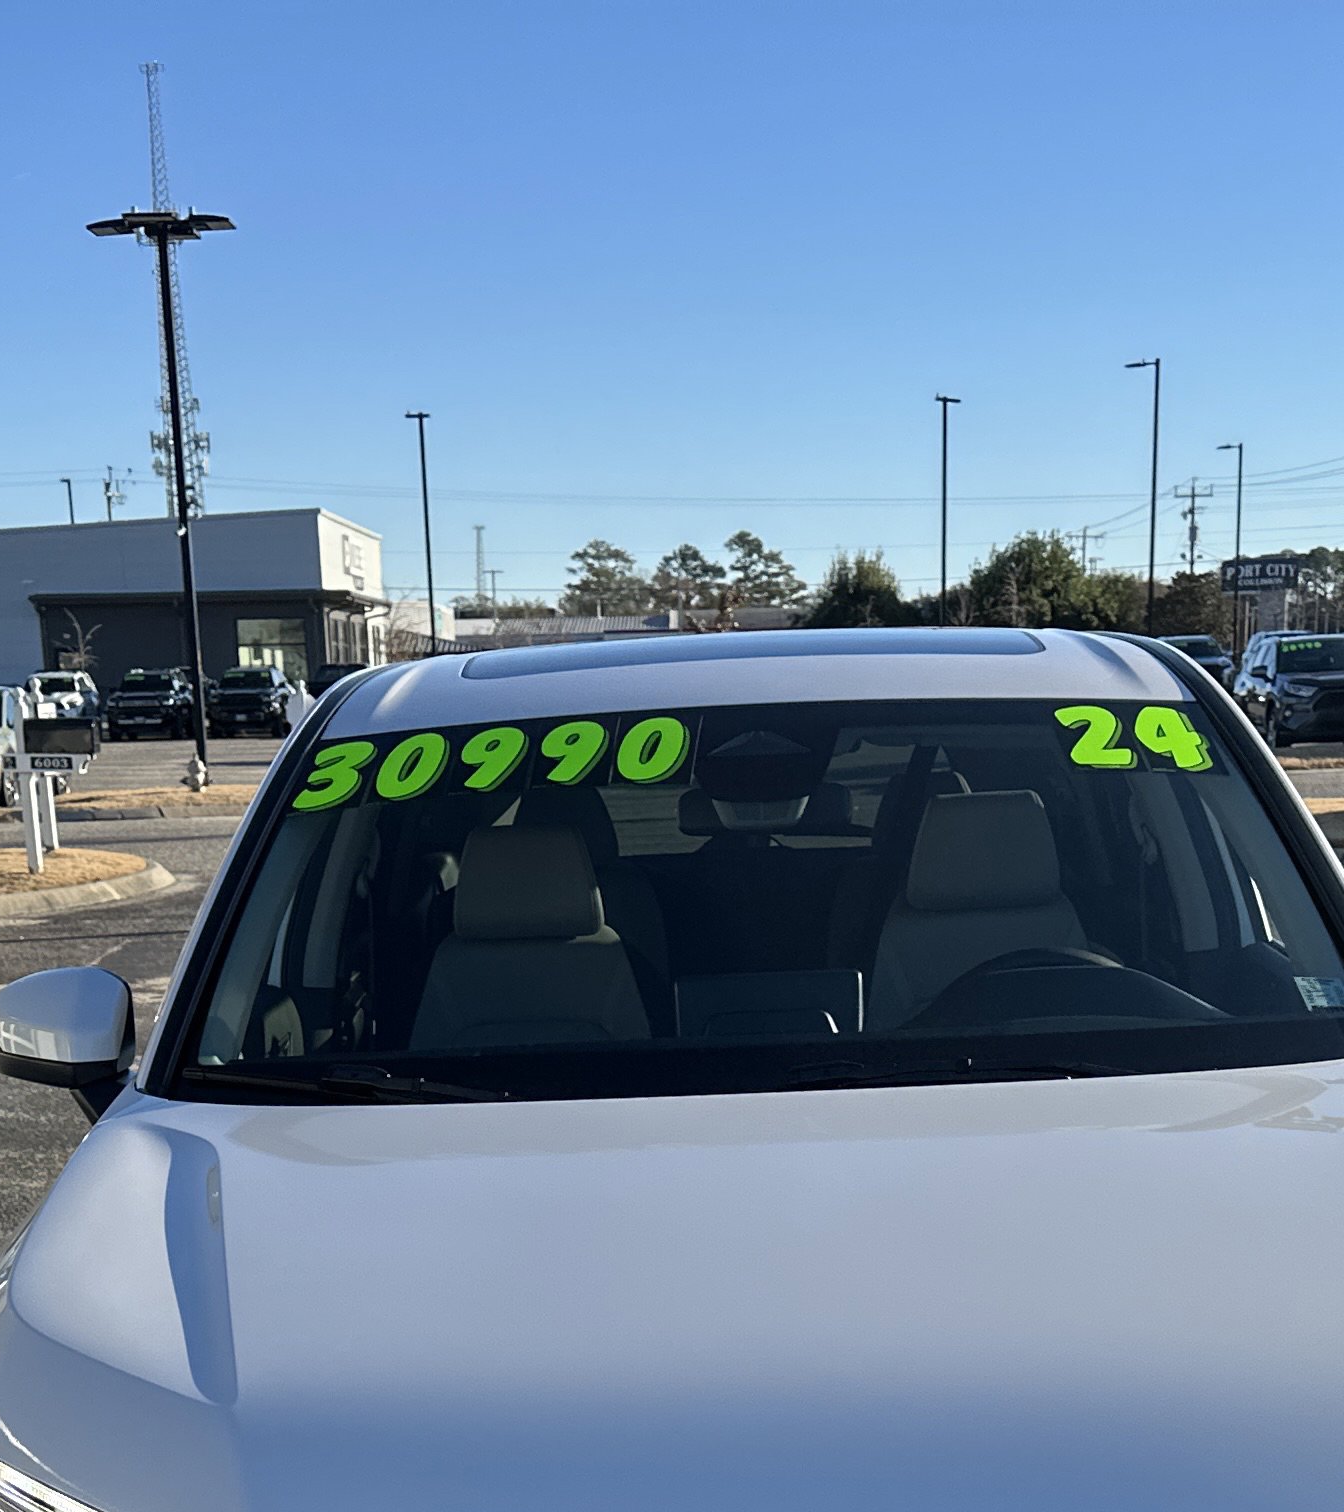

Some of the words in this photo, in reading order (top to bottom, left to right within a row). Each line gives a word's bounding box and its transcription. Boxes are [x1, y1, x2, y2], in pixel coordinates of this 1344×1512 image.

[1266, 563, 1296, 577] CITY
[34, 758, 69, 768] 6003
[292, 716, 690, 812] 30990
[1055, 704, 1214, 773] 24
